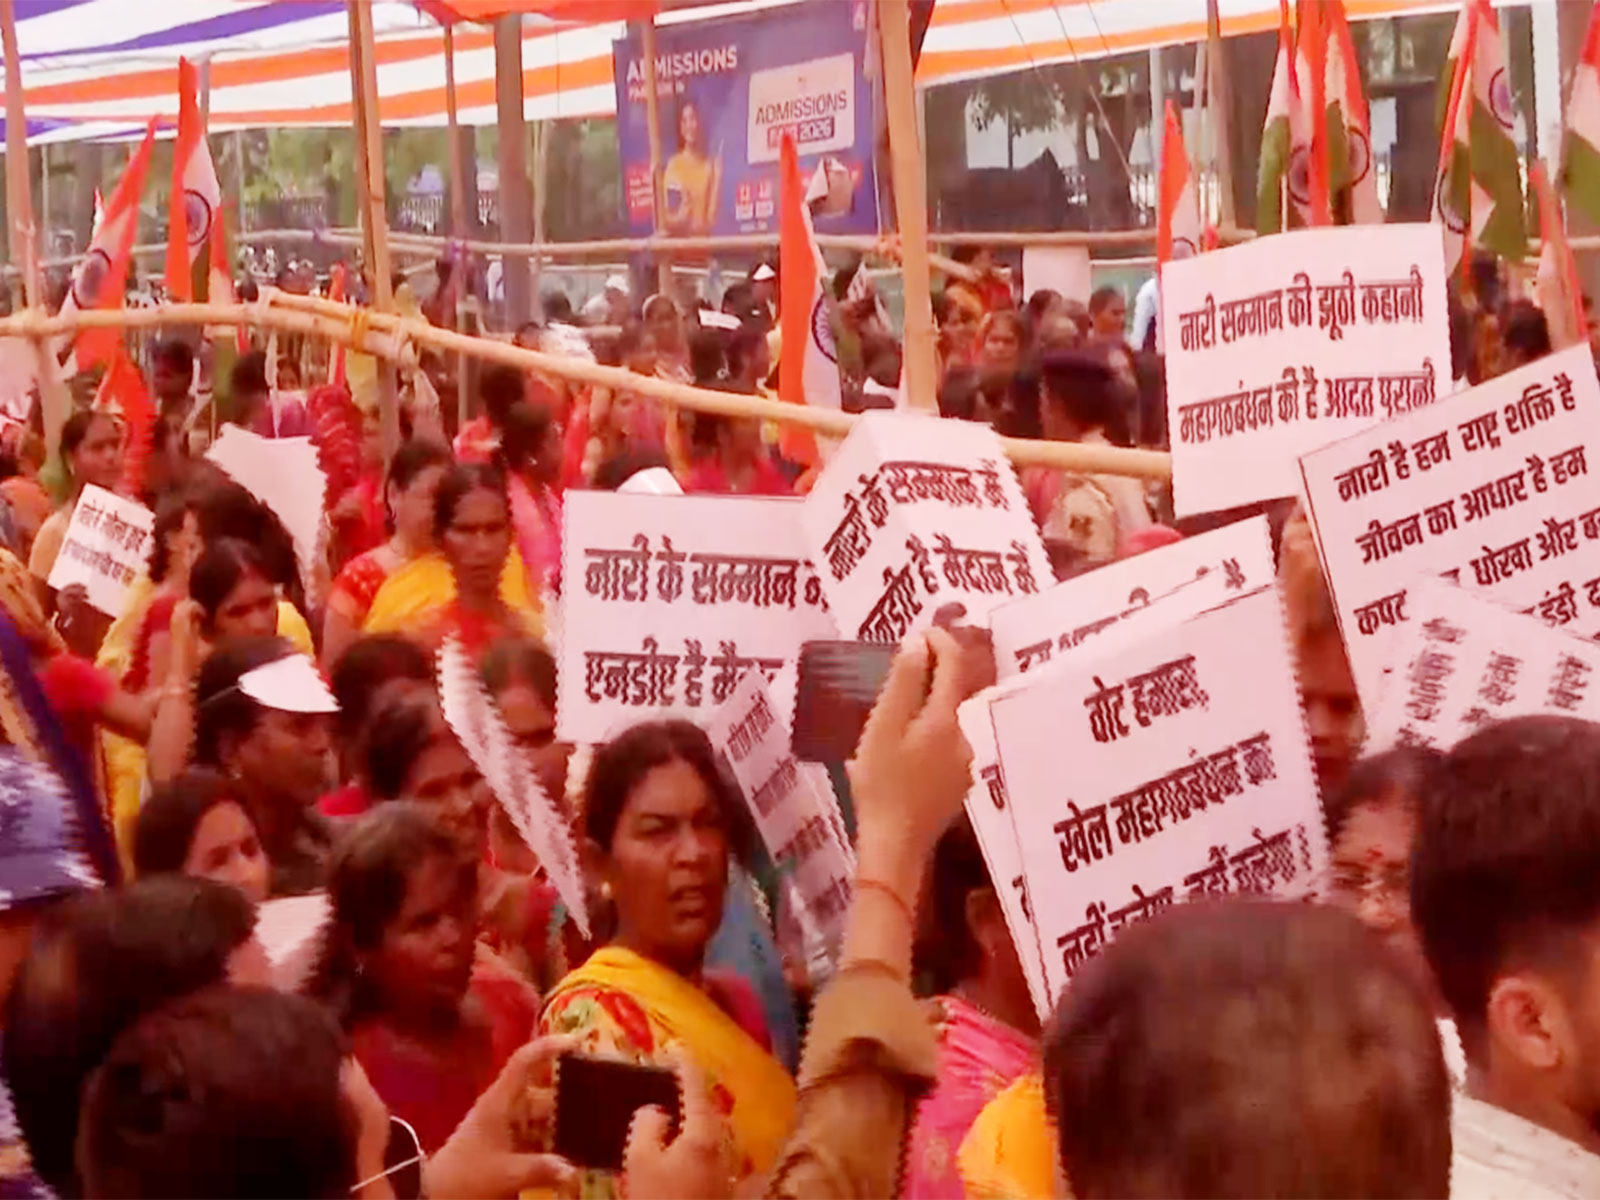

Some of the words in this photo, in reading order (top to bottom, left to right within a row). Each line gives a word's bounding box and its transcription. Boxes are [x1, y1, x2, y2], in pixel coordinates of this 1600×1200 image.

[756, 90, 847, 125] ADMISSIONS
[1179, 293, 1217, 351] नारी
[1219, 289, 1284, 343] सम्मान
[1286, 271, 1312, 328] की
[1316, 267, 1356, 340] झूठी
[1359, 264, 1424, 324] कहानी
[1178, 380, 1274, 444] महागठबंधन
[1276, 366, 1300, 422] की
[1302, 366, 1318, 419] है
[1324, 376, 1374, 418] आदत
[1377, 356, 1436, 422] परानी
[1334, 449, 1390, 502] नारी
[1388, 440, 1411, 479] है
[1411, 430, 1451, 471] हम
[1457, 411, 1502, 451] राष्ट्र
[1503, 383, 1556, 435] शक्ति
[1553, 372, 1576, 411] है
[1355, 519, 1424, 565] जीवन
[1424, 499, 1459, 535] का
[1460, 470, 1529, 523] आधार
[1525, 453, 1548, 493] है
[1549, 445, 1588, 484] हम
[1536, 516, 1579, 561] और
[584, 533, 652, 602] नारी
[655, 534, 687, 603] के
[689, 552, 800, 610] सम्मान
[584, 633, 681, 707] एनडीए
[683, 638, 707, 708] है
[1083, 675, 1130, 743] वोट
[1053, 798, 1114, 872] खेल
